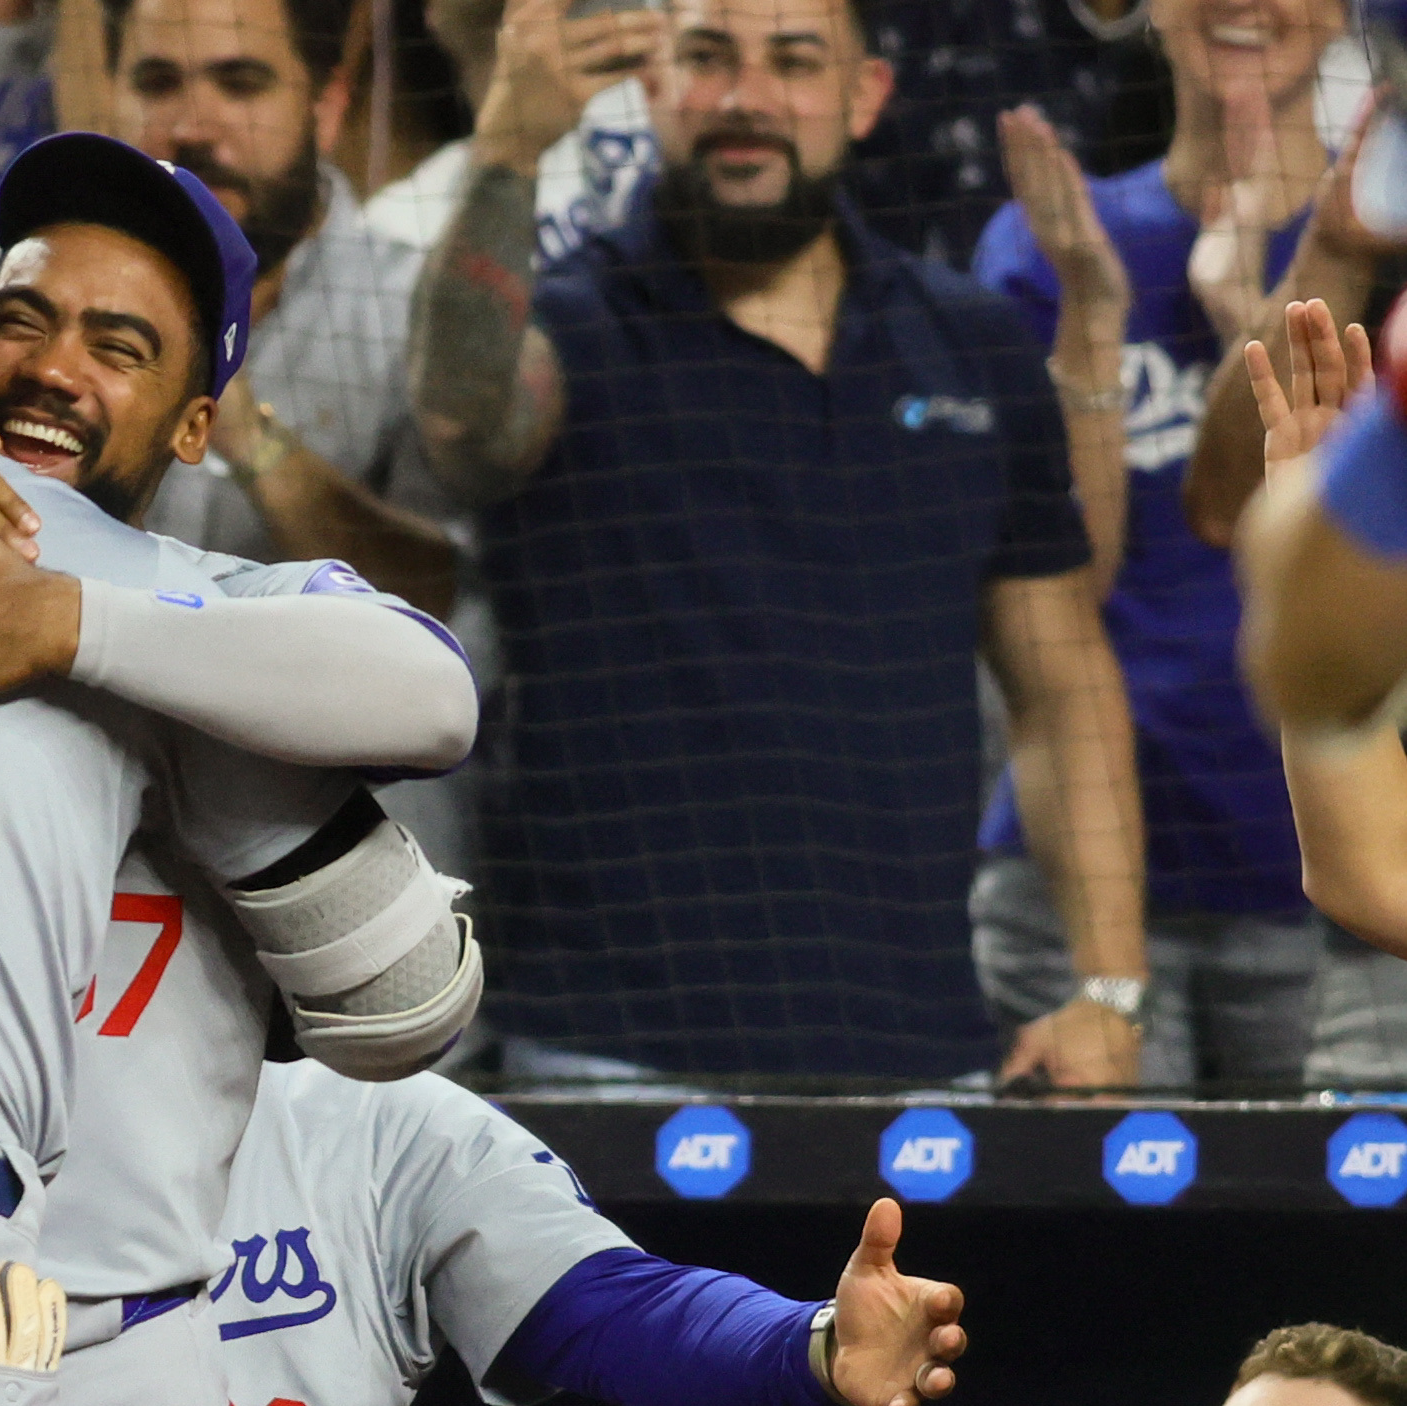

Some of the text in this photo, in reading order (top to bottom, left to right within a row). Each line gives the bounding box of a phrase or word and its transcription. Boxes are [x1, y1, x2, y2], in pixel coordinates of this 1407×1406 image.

[74, 891, 184, 1038] 7
[667, 1133, 737, 1170] ADT
[892, 1137, 962, 1173] ADT
[1114, 1140, 1185, 1175] ADT
[1338, 1142, 1407, 1178] ADT
